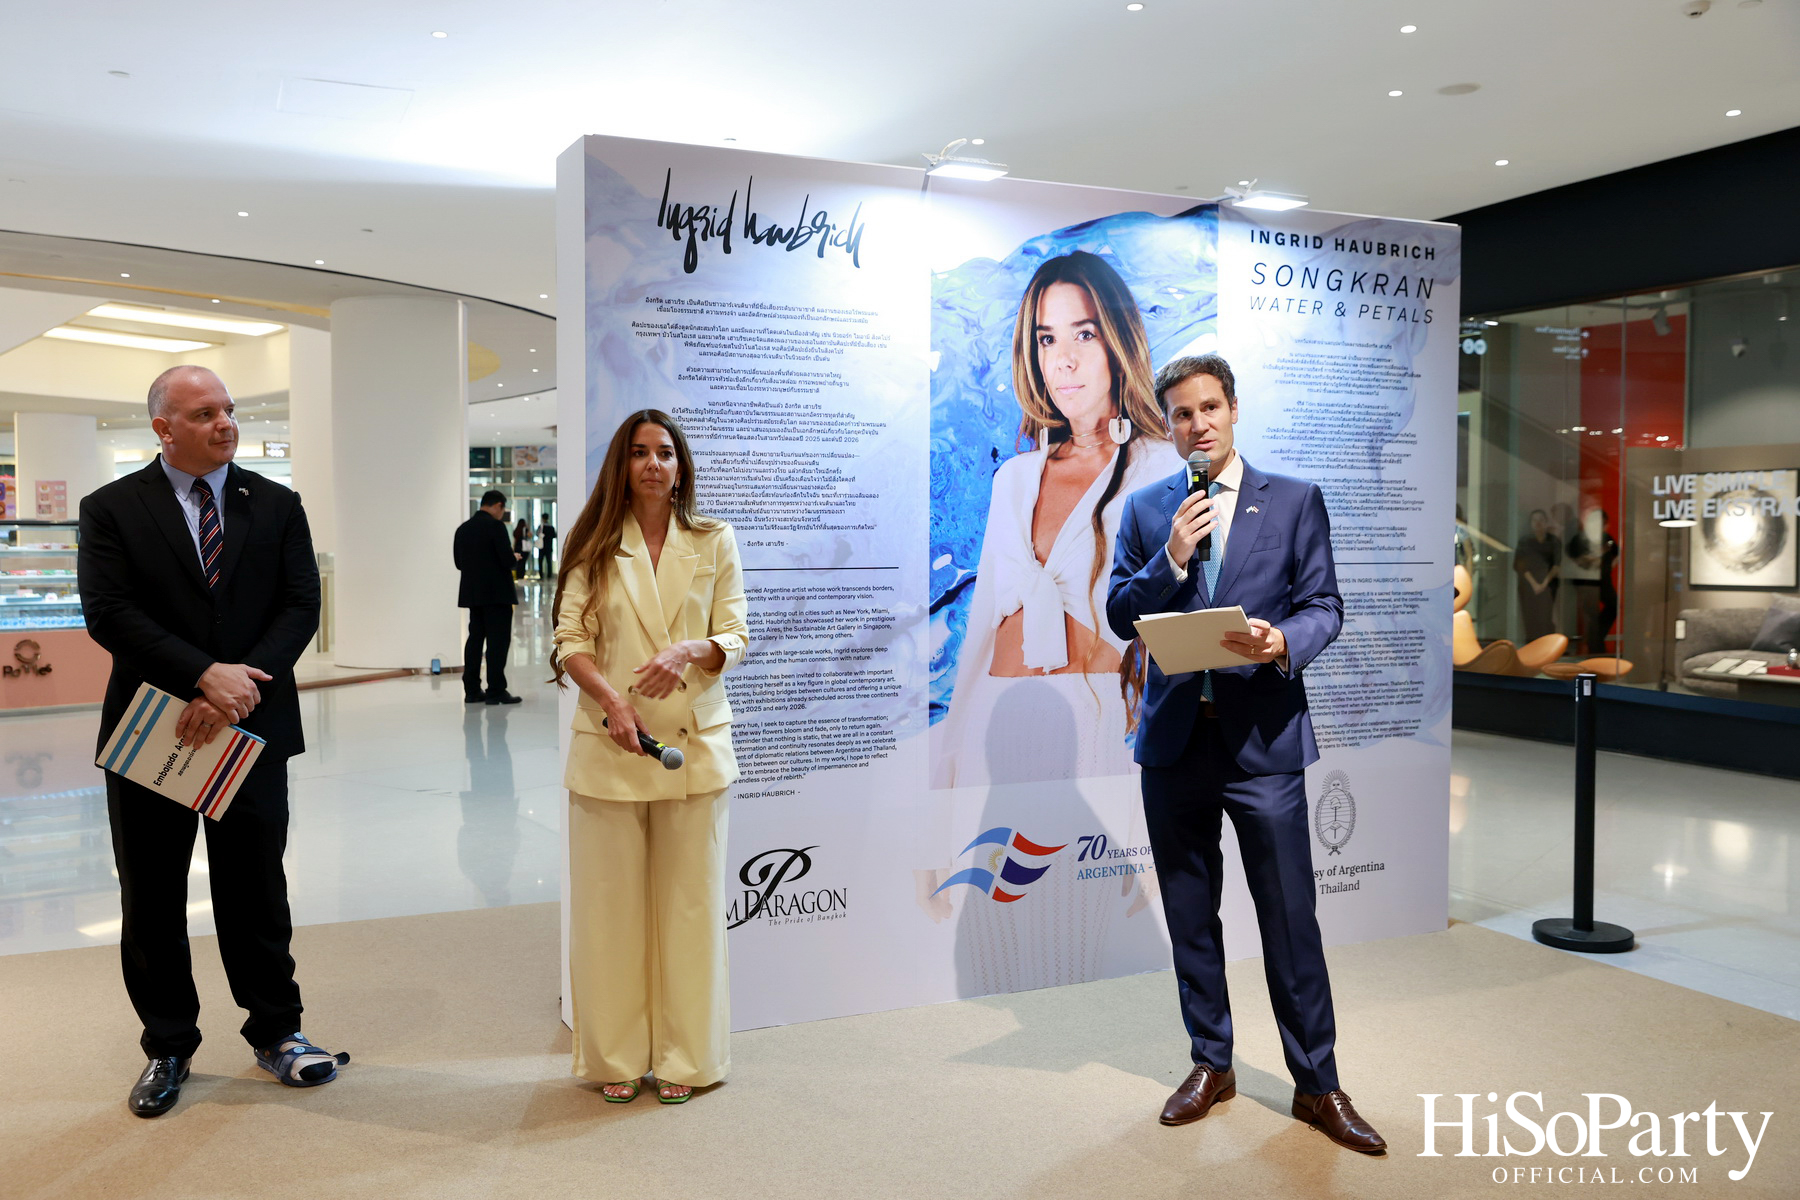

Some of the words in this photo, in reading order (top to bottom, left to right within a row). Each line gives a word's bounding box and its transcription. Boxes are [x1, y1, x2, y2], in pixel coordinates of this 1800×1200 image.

[1251, 229, 1323, 249] INGRID
[1334, 238, 1435, 260] HAUBRICH
[1251, 262, 1434, 299] SONGKRAN
[1250, 296, 1323, 315] WATER
[1334, 301, 1346, 317] &
[1358, 304, 1434, 324] PETALS
[1653, 474, 1697, 495] LIVE
[1703, 470, 1788, 492] SIMPLE
[1653, 498, 1697, 519] LIVE
[762, 586, 791, 595] Argentine
[791, 585, 807, 593] artist
[841, 584, 871, 592] transcends
[872, 584, 894, 592] borders,
[762, 610, 787, 619] standing
[787, 609, 798, 617] out
[820, 608, 834, 616] such
[856, 607, 870, 616] York,
[871, 607, 890, 615] Miami,
[802, 616, 834, 624] showcased
[844, 615, 859, 623] work
[865, 615, 896, 624] prestigious
[765, 625, 782, 633] Aires,
[793, 624, 826, 632] Sustainable
[836, 623, 856, 632] Gallery
[862, 622, 892, 632] Singapore,
[757, 633, 778, 642] Gallery
[784, 632, 799, 640] New
[799, 632, 814, 640] York,
[834, 631, 854, 639] others.
[765, 657, 777, 665] and
[787, 656, 807, 664] human
[808, 655, 839, 663] connection
[839, 654, 852, 662] with
[724, 674, 742, 683] Ingrid
[742, 673, 769, 681] Haubrich
[769, 672, 780, 680] has
[795, 671, 815, 679] invited
[822, 670, 853, 678] collaborate
[852, 669, 866, 677] with
[866, 668, 893, 678] important
[755, 696, 786, 704] exhibitions
[786, 695, 807, 704] already
[807, 693, 836, 701] scheduled
[870, 691, 899, 699] continents
[774, 703, 788, 713] early
[788, 702, 807, 710] 2026.
[746, 720, 760, 729] hue,
[763, 719, 778, 727] seek
[784, 718, 807, 728] capture
[807, 717, 817, 725] the
[847, 714, 888, 724] transformation;
[746, 752, 754, 760] of
[754, 751, 784, 761] diplomatic
[784, 749, 809, 757] relations
[809, 748, 834, 756] between
[834, 746, 861, 756] Argentina
[861, 745, 873, 753] and
[873, 744, 897, 753] Thailand,
[153, 753, 179, 787] Embajada
[737, 775, 760, 784] endless
[760, 774, 776, 784] cycle
[783, 772, 806, 780] rebirth."
[737, 791, 761, 799] INGRID
[761, 789, 795, 798] HAUBRICH
[1077, 834, 1107, 862] 70
[1107, 847, 1138, 859] YEARS
[1076, 864, 1145, 880] ARGENTINA
[1327, 865, 1337, 877] of
[1338, 861, 1385, 877] Argentina
[1319, 880, 1360, 895] Thailand
[742, 888, 848, 920] PARAGON
[785, 917, 803, 925] Pride
[807, 915, 814, 923] of
[817, 912, 847, 921] Bangkok
